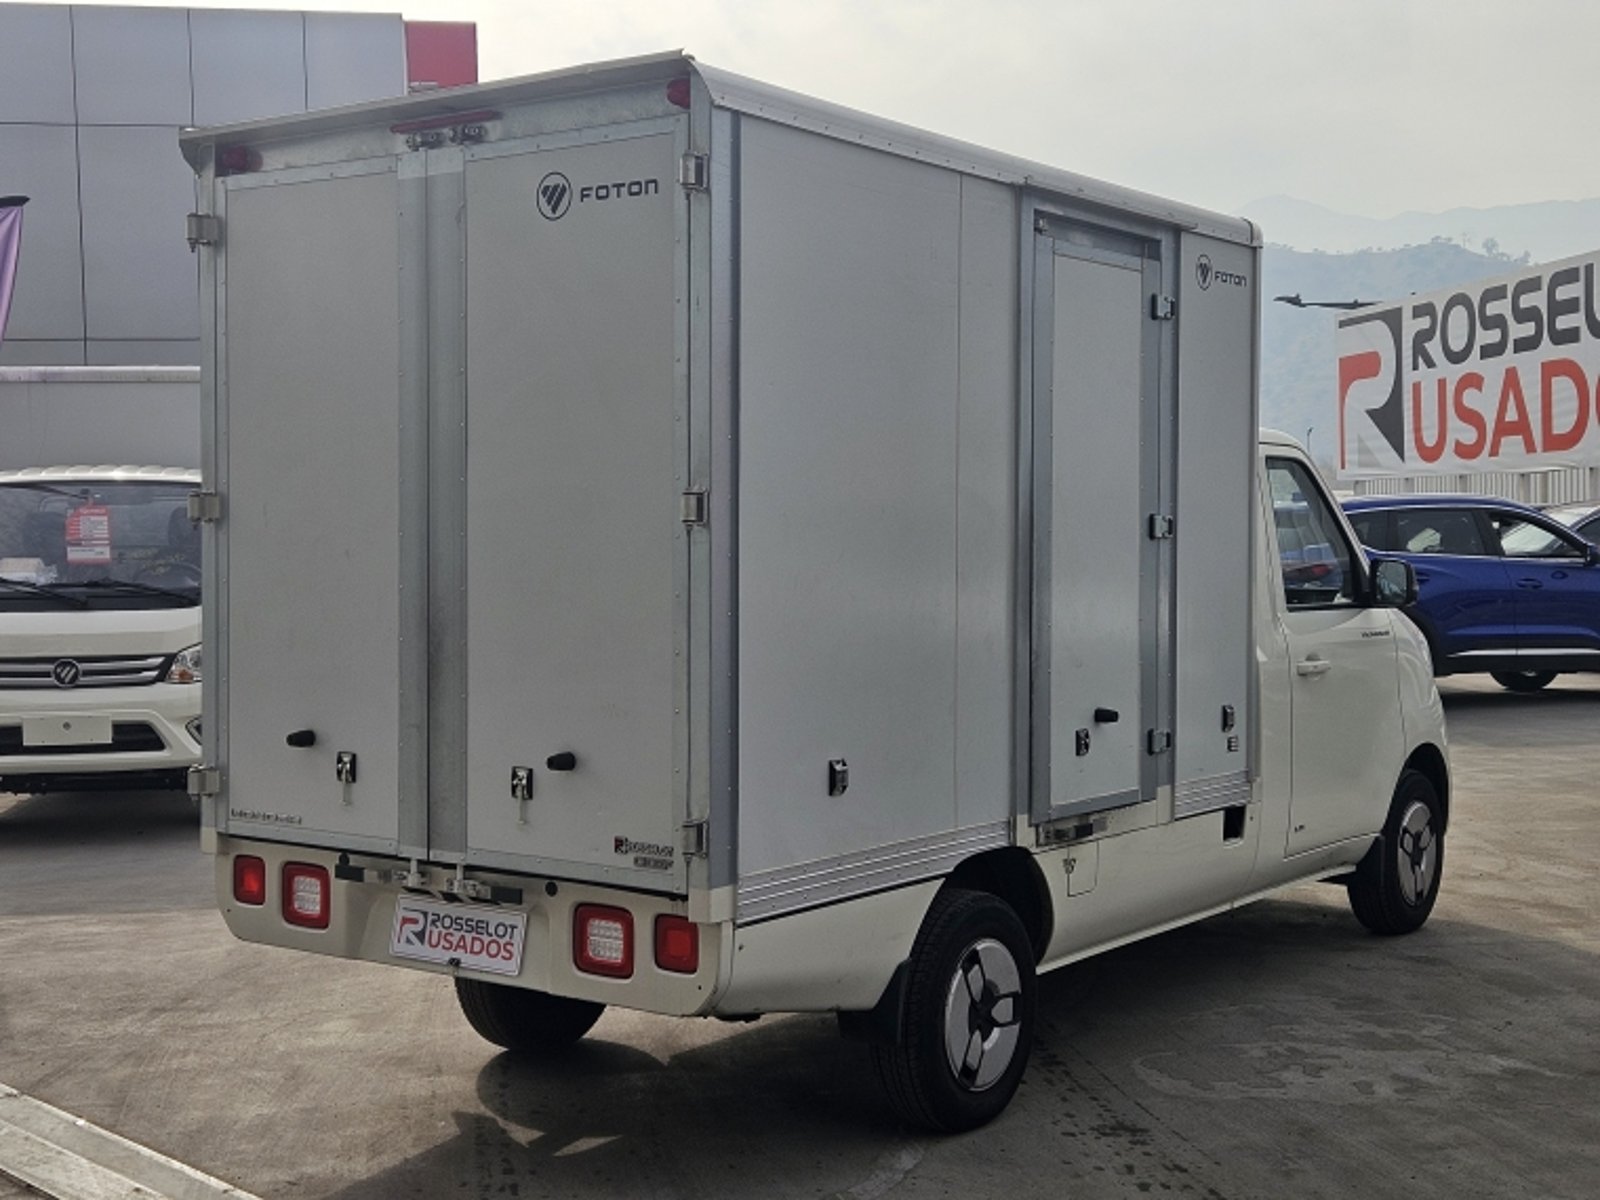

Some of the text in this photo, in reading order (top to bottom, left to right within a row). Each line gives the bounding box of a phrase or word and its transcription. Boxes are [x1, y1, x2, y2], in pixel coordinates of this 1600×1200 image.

[580, 178, 659, 203] FOTON
[1214, 271, 1247, 287] FOTON
[1411, 358, 1600, 464] USAD
[429, 913, 519, 940] ROSSELOT
[428, 930, 515, 961] USADOS
